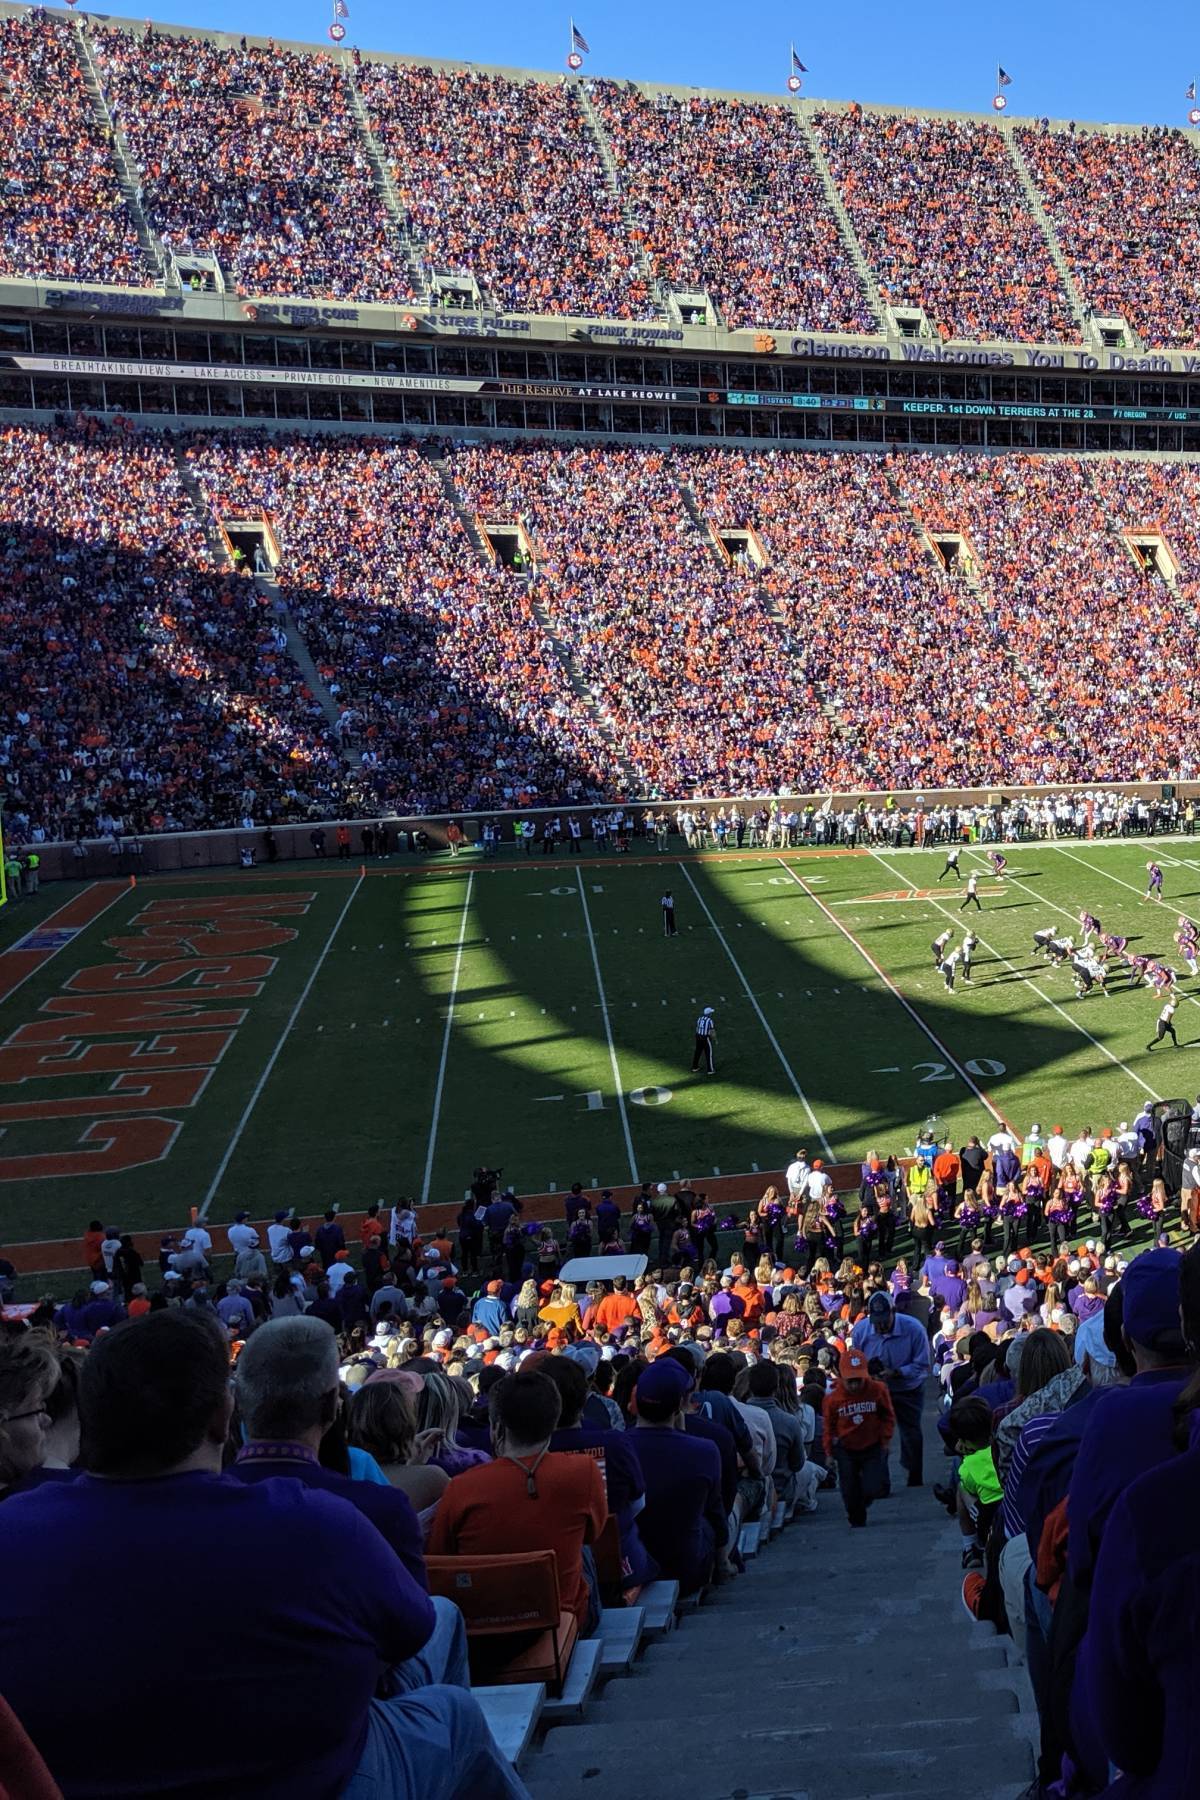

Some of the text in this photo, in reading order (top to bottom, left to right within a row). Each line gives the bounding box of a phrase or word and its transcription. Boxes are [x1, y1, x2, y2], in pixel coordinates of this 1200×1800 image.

[283, 305, 319, 318] FRED
[322, 308, 359, 321] CONE
[440, 316, 479, 327] STEVE
[482, 318, 530, 331] FULLER
[588, 325, 684, 340] FRANK HOWARD
[791, 337, 891, 359] Clemson
[901, 343, 1015, 366] Welcomes
[1025, 350, 1065, 368] You
[1074, 353, 1100, 370] To
[1110, 354, 1172, 373] Death
[53, 360, 172, 376] BREATHTAKING VIEWS
[194, 368, 264, 380] LAKE ACCESS
[284, 372, 354, 385] PRIVATE GOLF
[374, 376, 451, 389] NEW AMENITIES
[499, 383, 527, 394] THE
[527, 385, 573, 396] RESERVE
[598, 390, 627, 398] LAKE
[632, 391, 678, 400] KEOWEE
[903, 402, 1097, 418] KEEPER. 1st DOWN TERRIERS AT THE 28.
[912, 1057, 1007, 1083] 20
[575, 1085, 673, 1111] 10
[838, 1402, 877, 1417] CLEMSON
